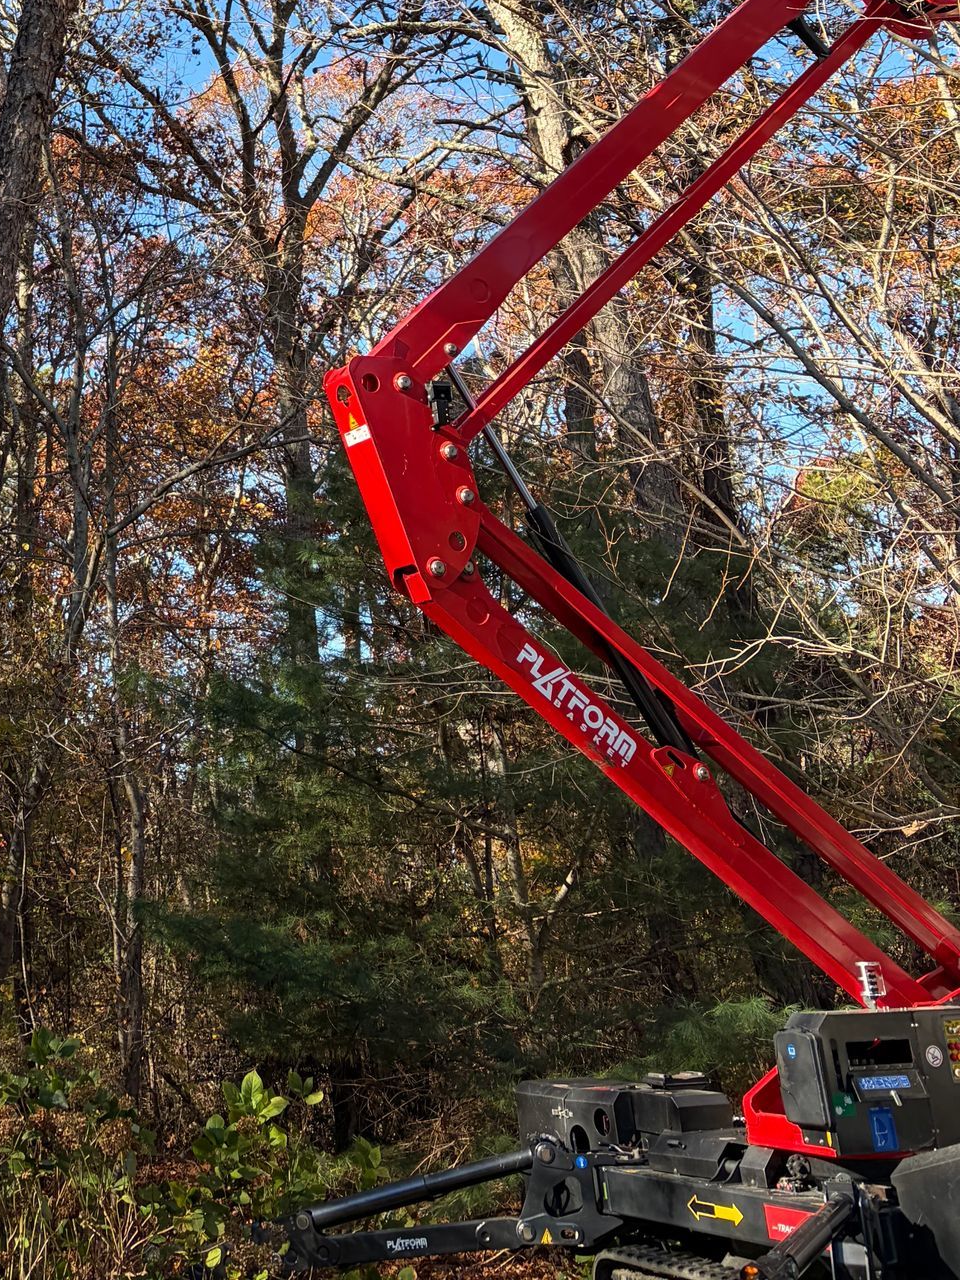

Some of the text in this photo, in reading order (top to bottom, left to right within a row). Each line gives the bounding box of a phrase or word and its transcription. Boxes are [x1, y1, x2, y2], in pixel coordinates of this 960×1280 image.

[516, 642, 637, 763] PLATFORM
[553, 698, 628, 768] BASKET
[386, 1237, 428, 1251] PLATFORM
